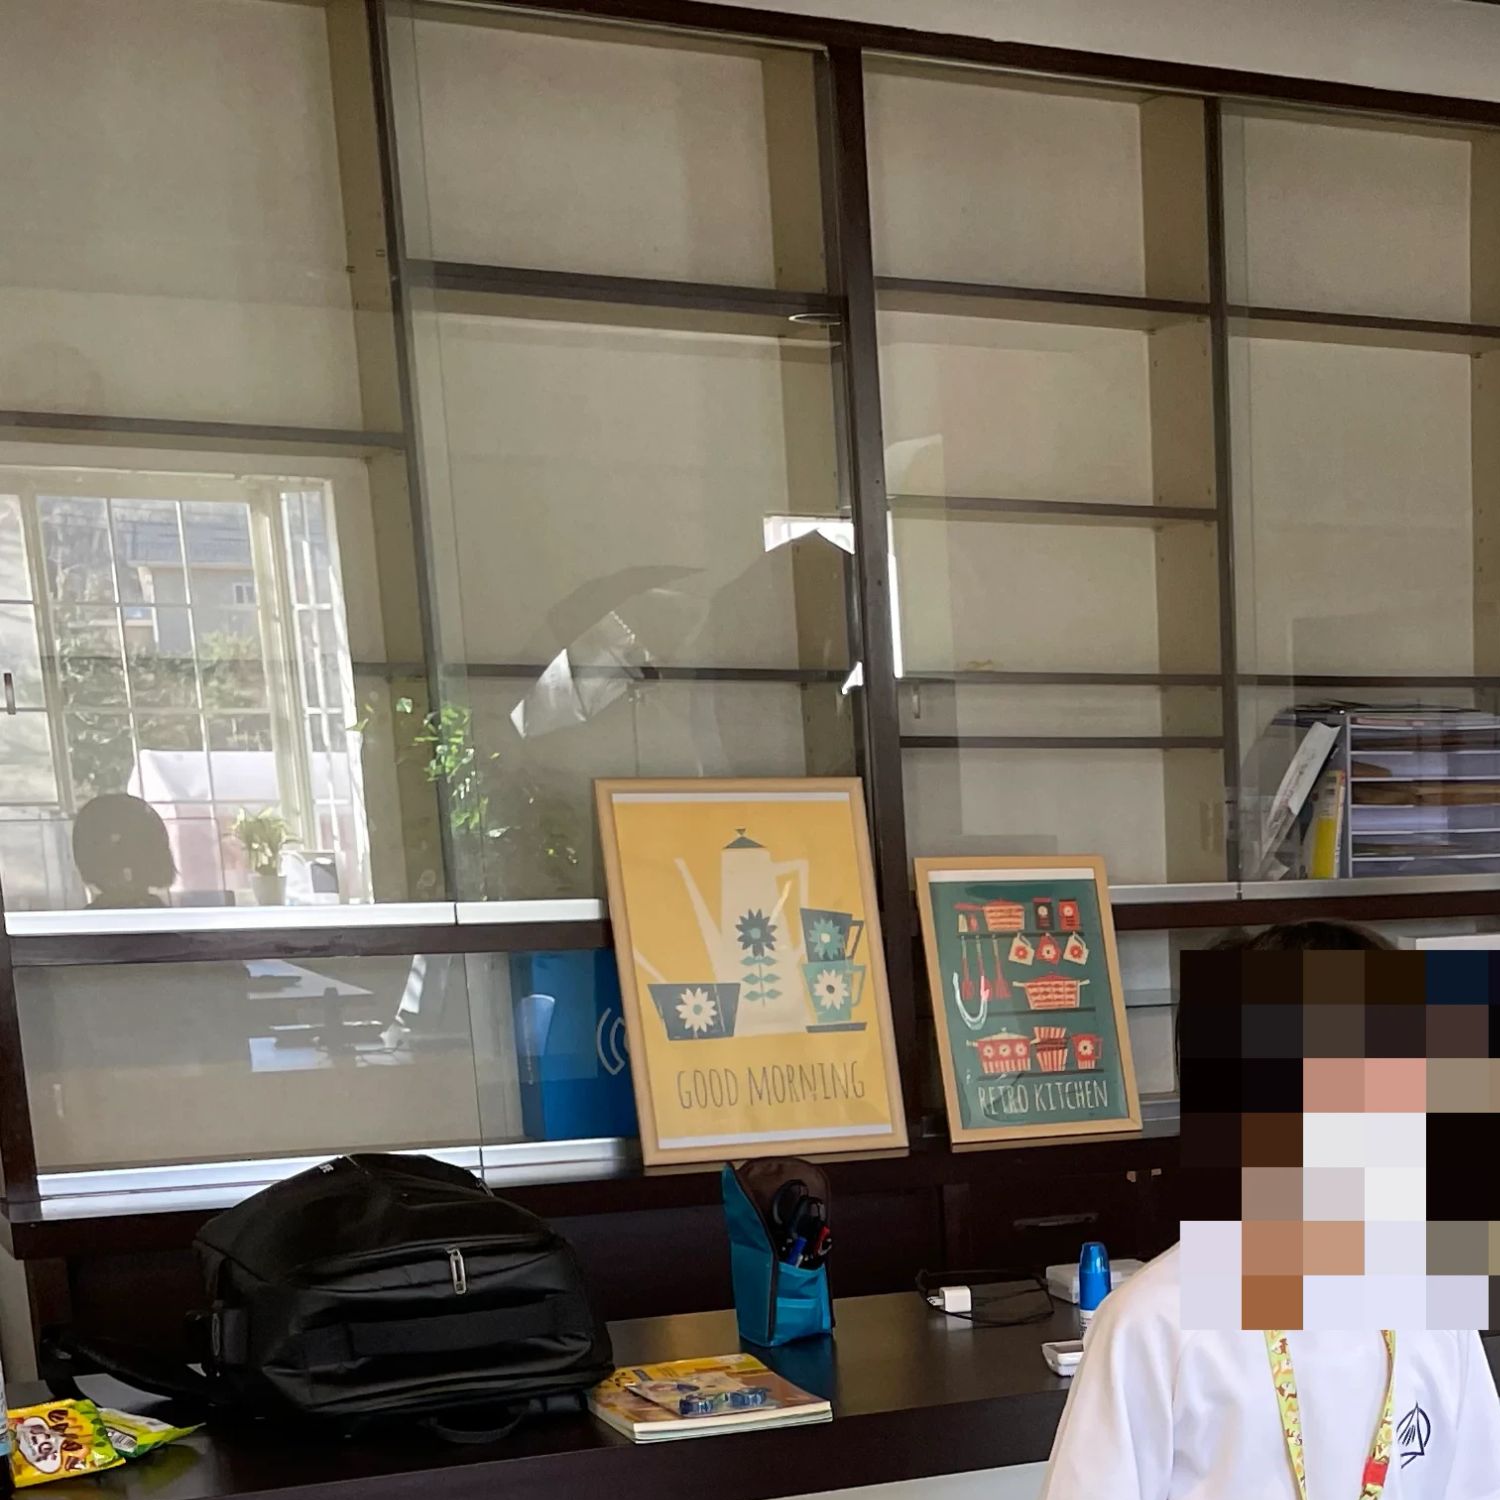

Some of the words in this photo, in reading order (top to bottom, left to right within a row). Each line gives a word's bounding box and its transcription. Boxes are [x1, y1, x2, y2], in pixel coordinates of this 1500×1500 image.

[677, 1068, 738, 1109] GOOD
[748, 1061, 865, 1106] MORNING
[978, 1084, 1029, 1115] RETRO
[1034, 1080, 1109, 1112] KITCHEN
